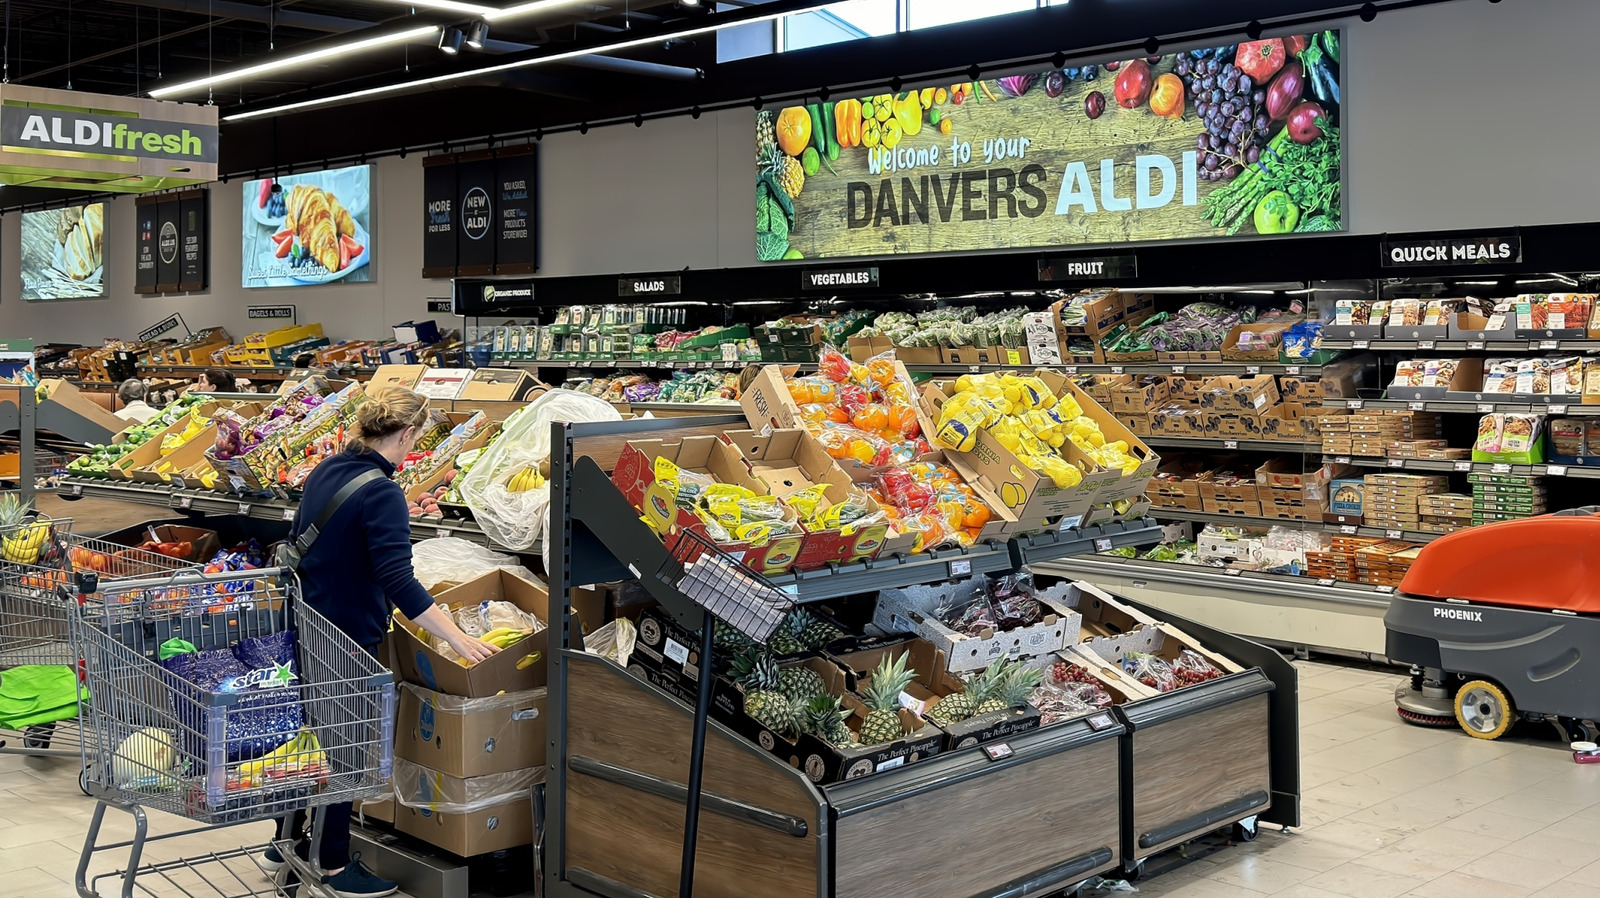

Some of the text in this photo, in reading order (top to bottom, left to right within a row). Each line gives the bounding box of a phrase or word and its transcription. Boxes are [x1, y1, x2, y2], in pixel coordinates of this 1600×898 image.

[20, 115, 202, 155] ALDIfresh
[868, 136, 1031, 175] Welcome to your
[847, 151, 1197, 229] DANVERS ALDI
[429, 200, 451, 213] MORE
[467, 196, 486, 208] NEW
[504, 209, 516, 218] MORE
[429, 224, 451, 233] FOR LESS
[467, 217, 487, 229] ALDI
[505, 219, 526, 228] PRODUCTS
[1391, 243, 1510, 262] QUICK MEALS
[269, 265, 287, 278] Little
[288, 261, 329, 280] Somethings
[1068, 262, 1103, 275] FRUIT
[634, 281, 664, 292] SALADS
[810, 272, 869, 286] VEGETABLES
[249, 310, 268, 318] BAGELS
[140, 331, 158, 342] BREAD
[162, 320, 177, 330] BUNS
[752, 388, 769, 417] FRESH
[973, 447, 990, 465] ONS
[976, 440, 1001, 465] ORNIA
[1433, 607, 1482, 622] PHOENIX
[665, 625, 690, 647] The Perfect
[233, 668, 278, 687] star
[651, 673, 660, 684] The
[662, 679, 678, 694] Perfect
[993, 725, 1010, 736] Perfect
[1010, 720, 1035, 731] Pineapple
[877, 740, 937, 762] The Perfect Pineapple
